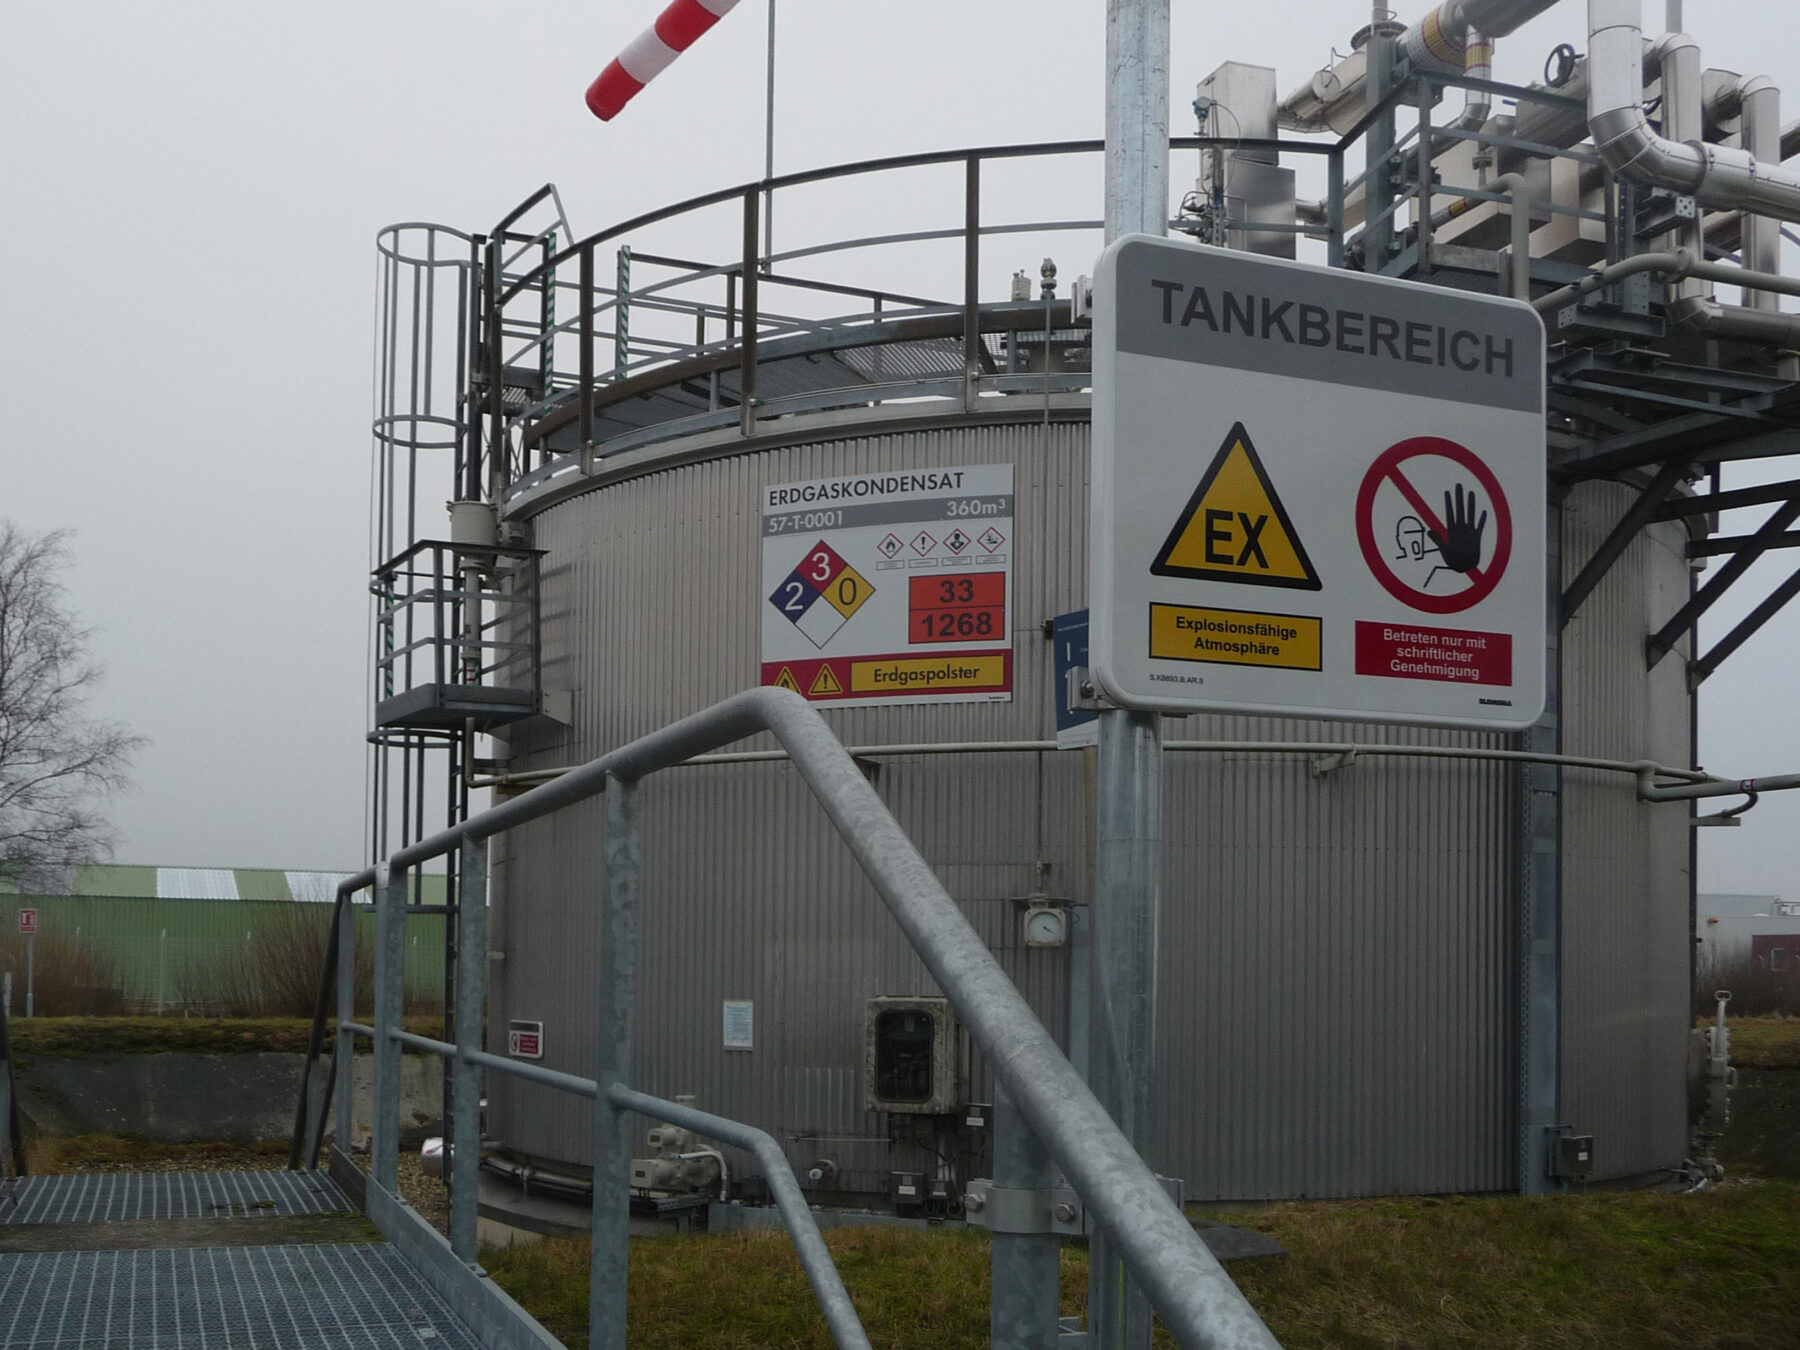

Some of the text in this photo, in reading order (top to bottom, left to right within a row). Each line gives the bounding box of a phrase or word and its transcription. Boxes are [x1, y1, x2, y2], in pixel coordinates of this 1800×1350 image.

[1150, 279, 1514, 377] TANKBEREICH
[768, 472, 964, 506] ERDGASKONDENSAT
[768, 511, 843, 533] 57-T-0001
[1204, 508, 1270, 569] EX
[811, 552, 831, 581] 3
[784, 582, 804, 611] 2
[838, 577, 857, 606] 0
[939, 579, 975, 603] 33
[922, 611, 993, 638] 1268
[1175, 615, 1298, 641] Explosionsfähige
[1193, 636, 1280, 656] Atmosphäre
[1383, 628, 1487, 649] Betreten nur mit
[1396, 646, 1474, 662] schriftlicher
[873, 664, 980, 686] Erdgaspolster
[1390, 659, 1480, 680] Genehmigung
